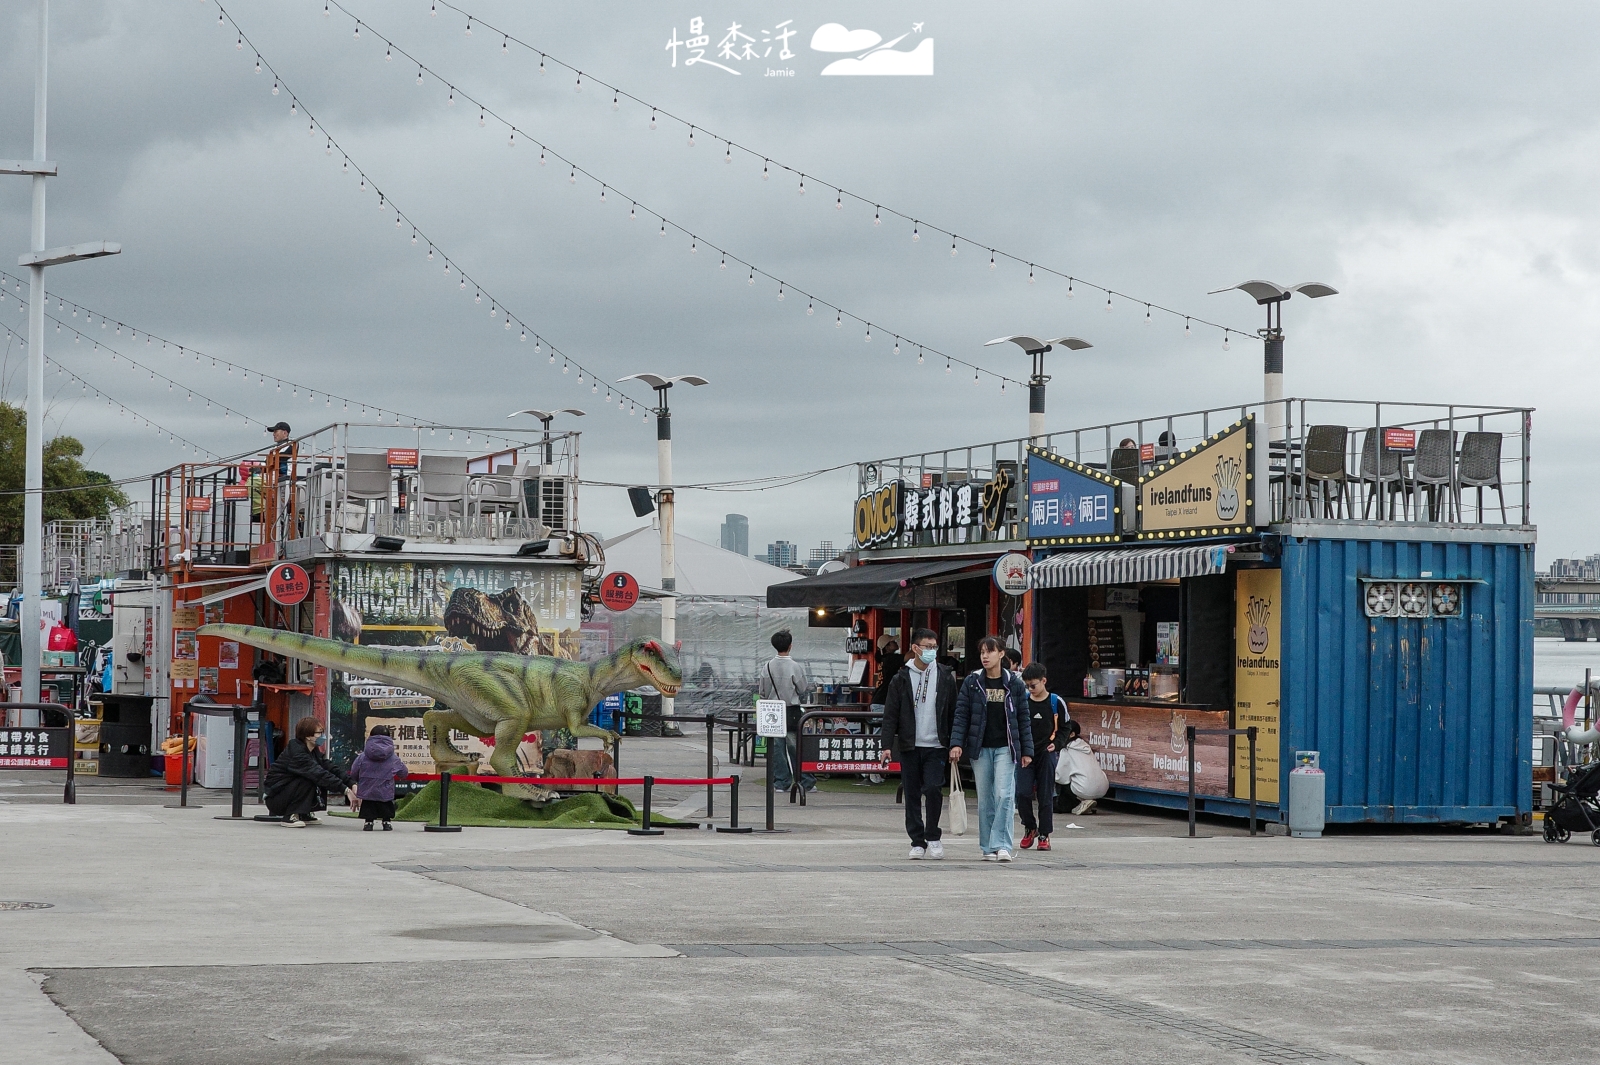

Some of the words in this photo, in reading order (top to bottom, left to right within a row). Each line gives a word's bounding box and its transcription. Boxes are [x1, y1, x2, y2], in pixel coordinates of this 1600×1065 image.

[855, 483, 897, 543] OMG!
[904, 484, 972, 530] 韓式料理
[1031, 498, 1059, 526] 倆月
[1078, 494, 1108, 523] 倆日
[1165, 508, 1178, 517] Taipei
[1183, 507, 1198, 515] Ireland
[276, 582, 304, 594] 服務台
[338, 565, 447, 618] DINOSAURS
[605, 589, 634, 600] 服務台
[846, 638, 868, 654] Chicken
[1237, 656, 1279, 669] Irelandfuns
[1101, 709, 1121, 730] 2/2
[1089, 731, 1110, 749] Lucky
[1110, 733, 1132, 748] House
